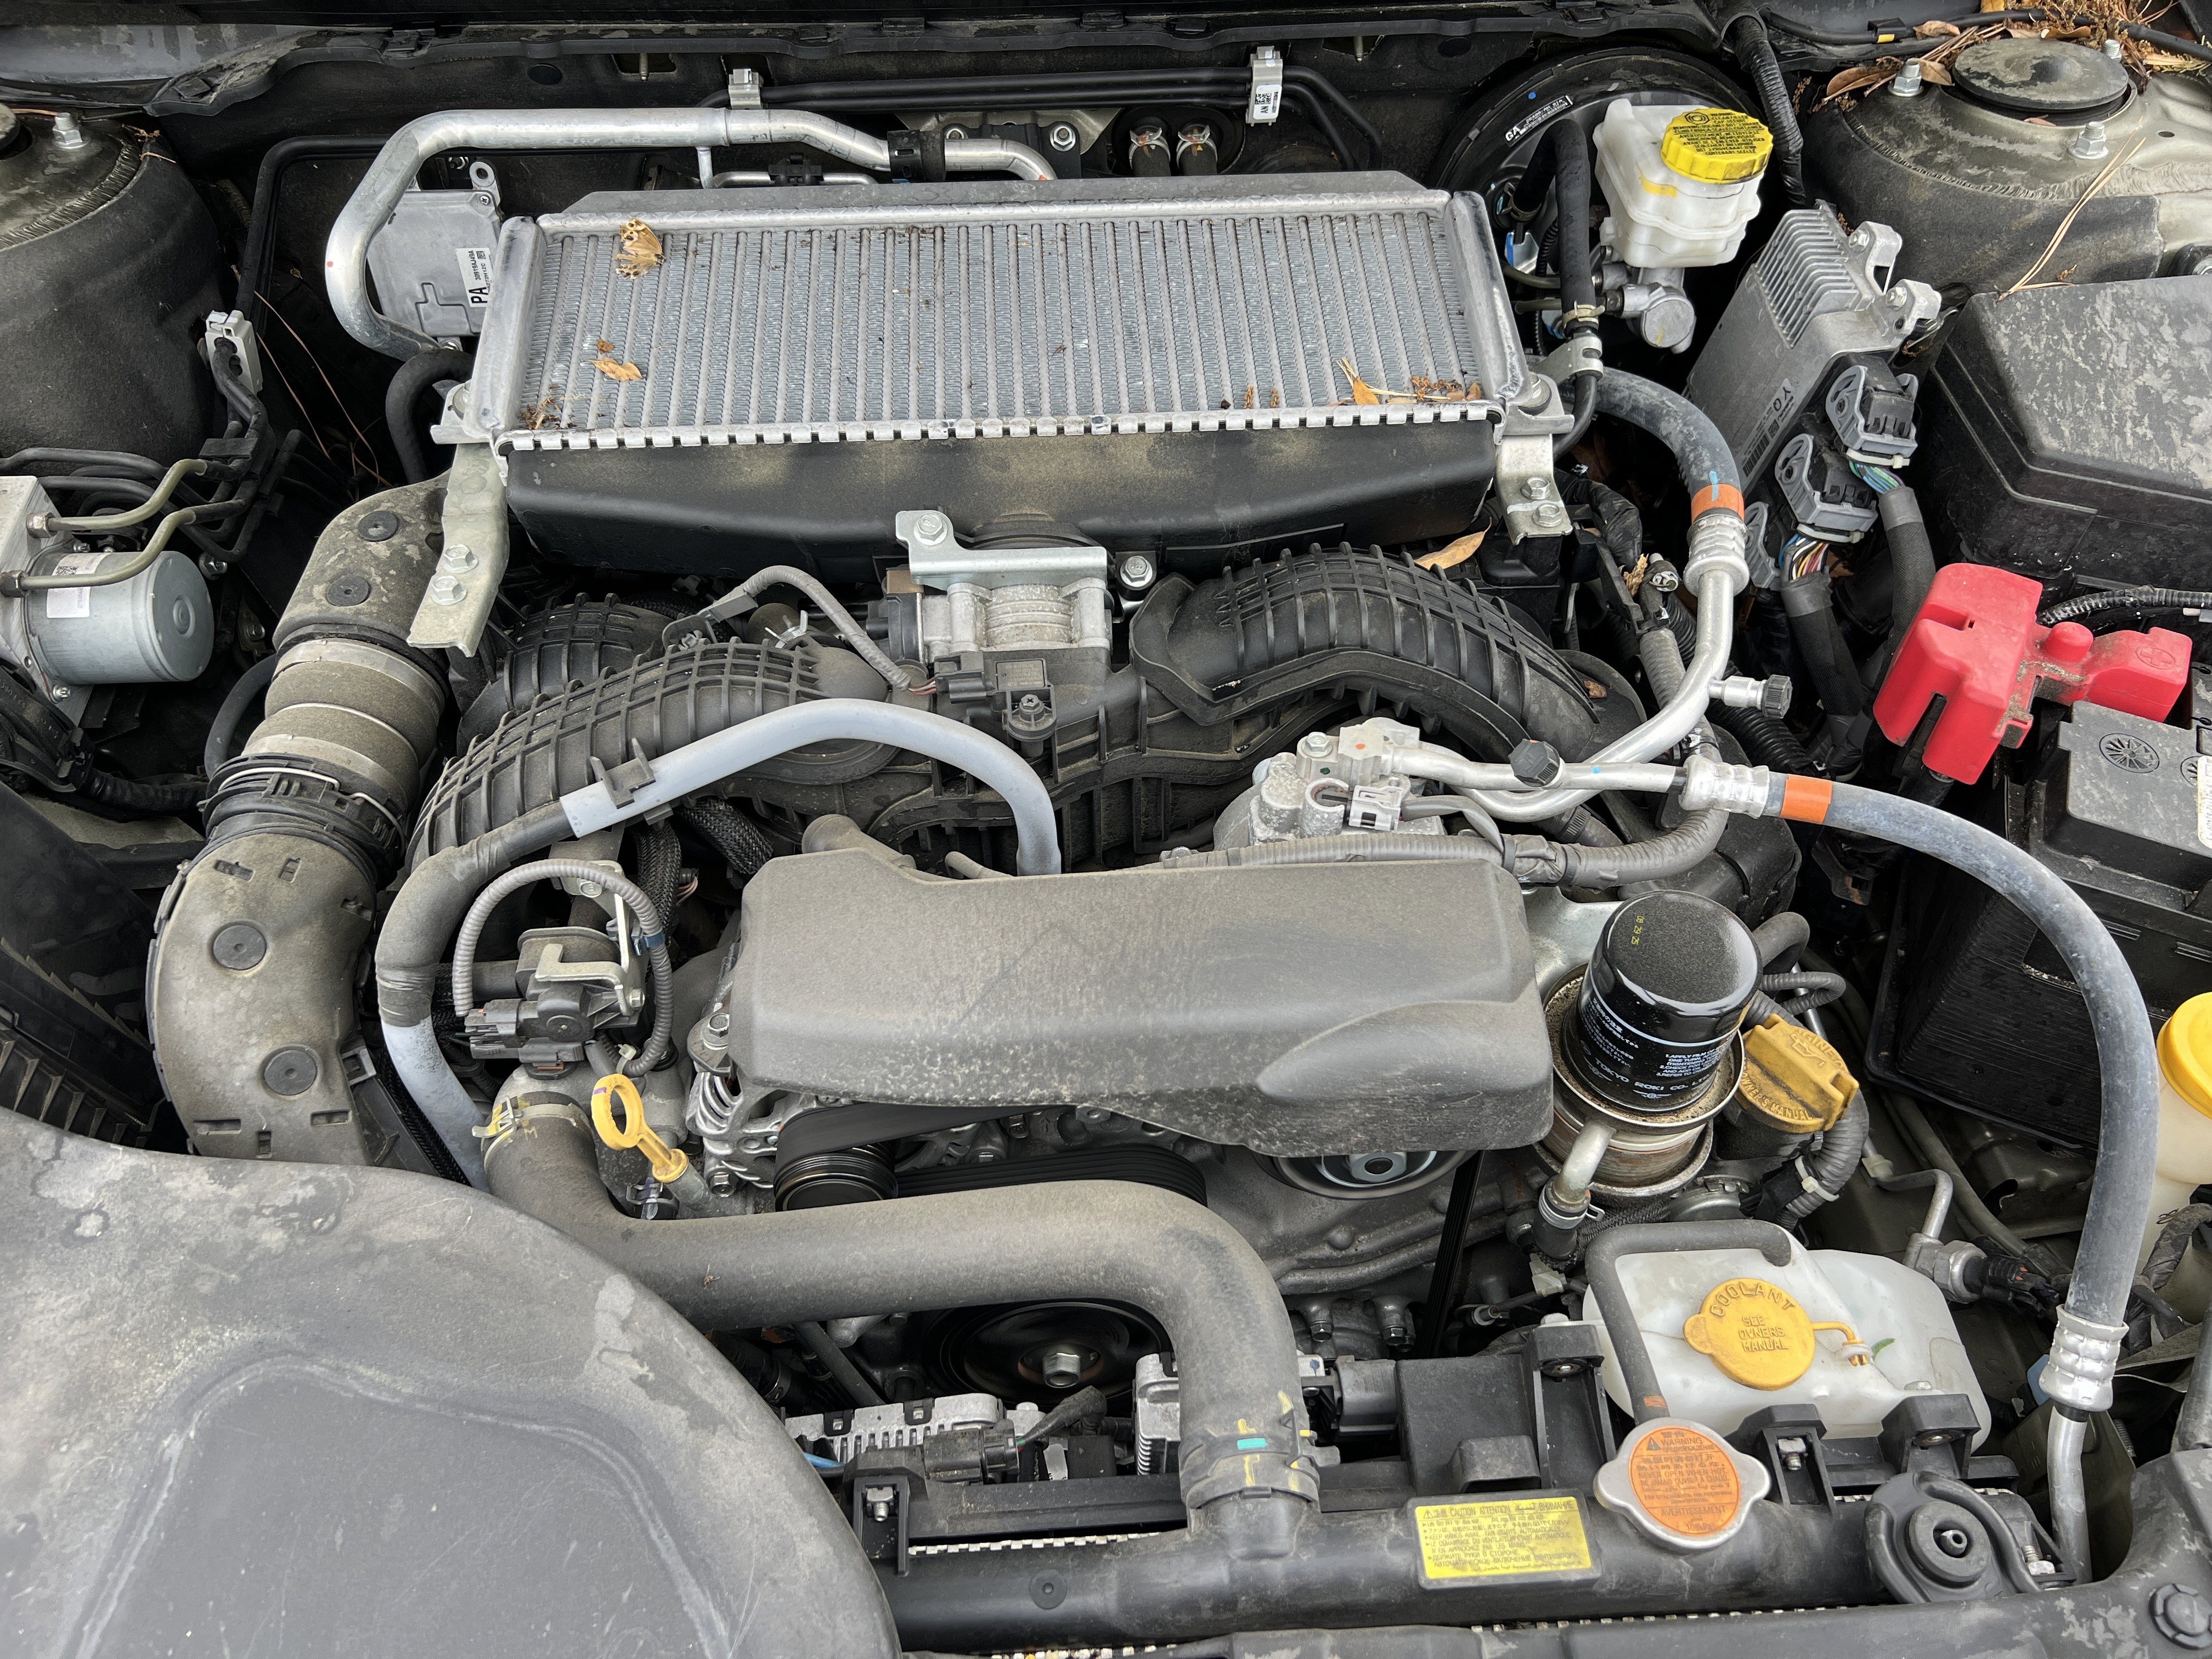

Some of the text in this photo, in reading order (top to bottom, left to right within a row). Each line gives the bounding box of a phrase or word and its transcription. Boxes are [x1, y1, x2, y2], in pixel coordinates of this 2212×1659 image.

[1505, 127, 1521, 142] GA
[468, 287, 489, 303] PA
[1595, 1058, 1629, 1082] TOKYO
[1634, 1081, 1664, 1091] ROKI
[1740, 1072, 1814, 1120] OWNER'S MANUAL
[1710, 1281, 1796, 1317] COOLANT
[1742, 1315, 1765, 1327] SEE
[1738, 1327, 1785, 1340] OWNERS
[1742, 1339, 1789, 1353] MANUAL
[1661, 1437, 1703, 1446] WARNING
[1450, 1507, 1476, 1516] CAUTION
[1480, 1504, 1510, 1515] ATTENTION
[1539, 1500, 1574, 1510] ВНИМАНИЕ
[1661, 1505, 1725, 1516] AVERTISSEMENT
[1449, 1544, 1480, 1553] APPROCHEZ
